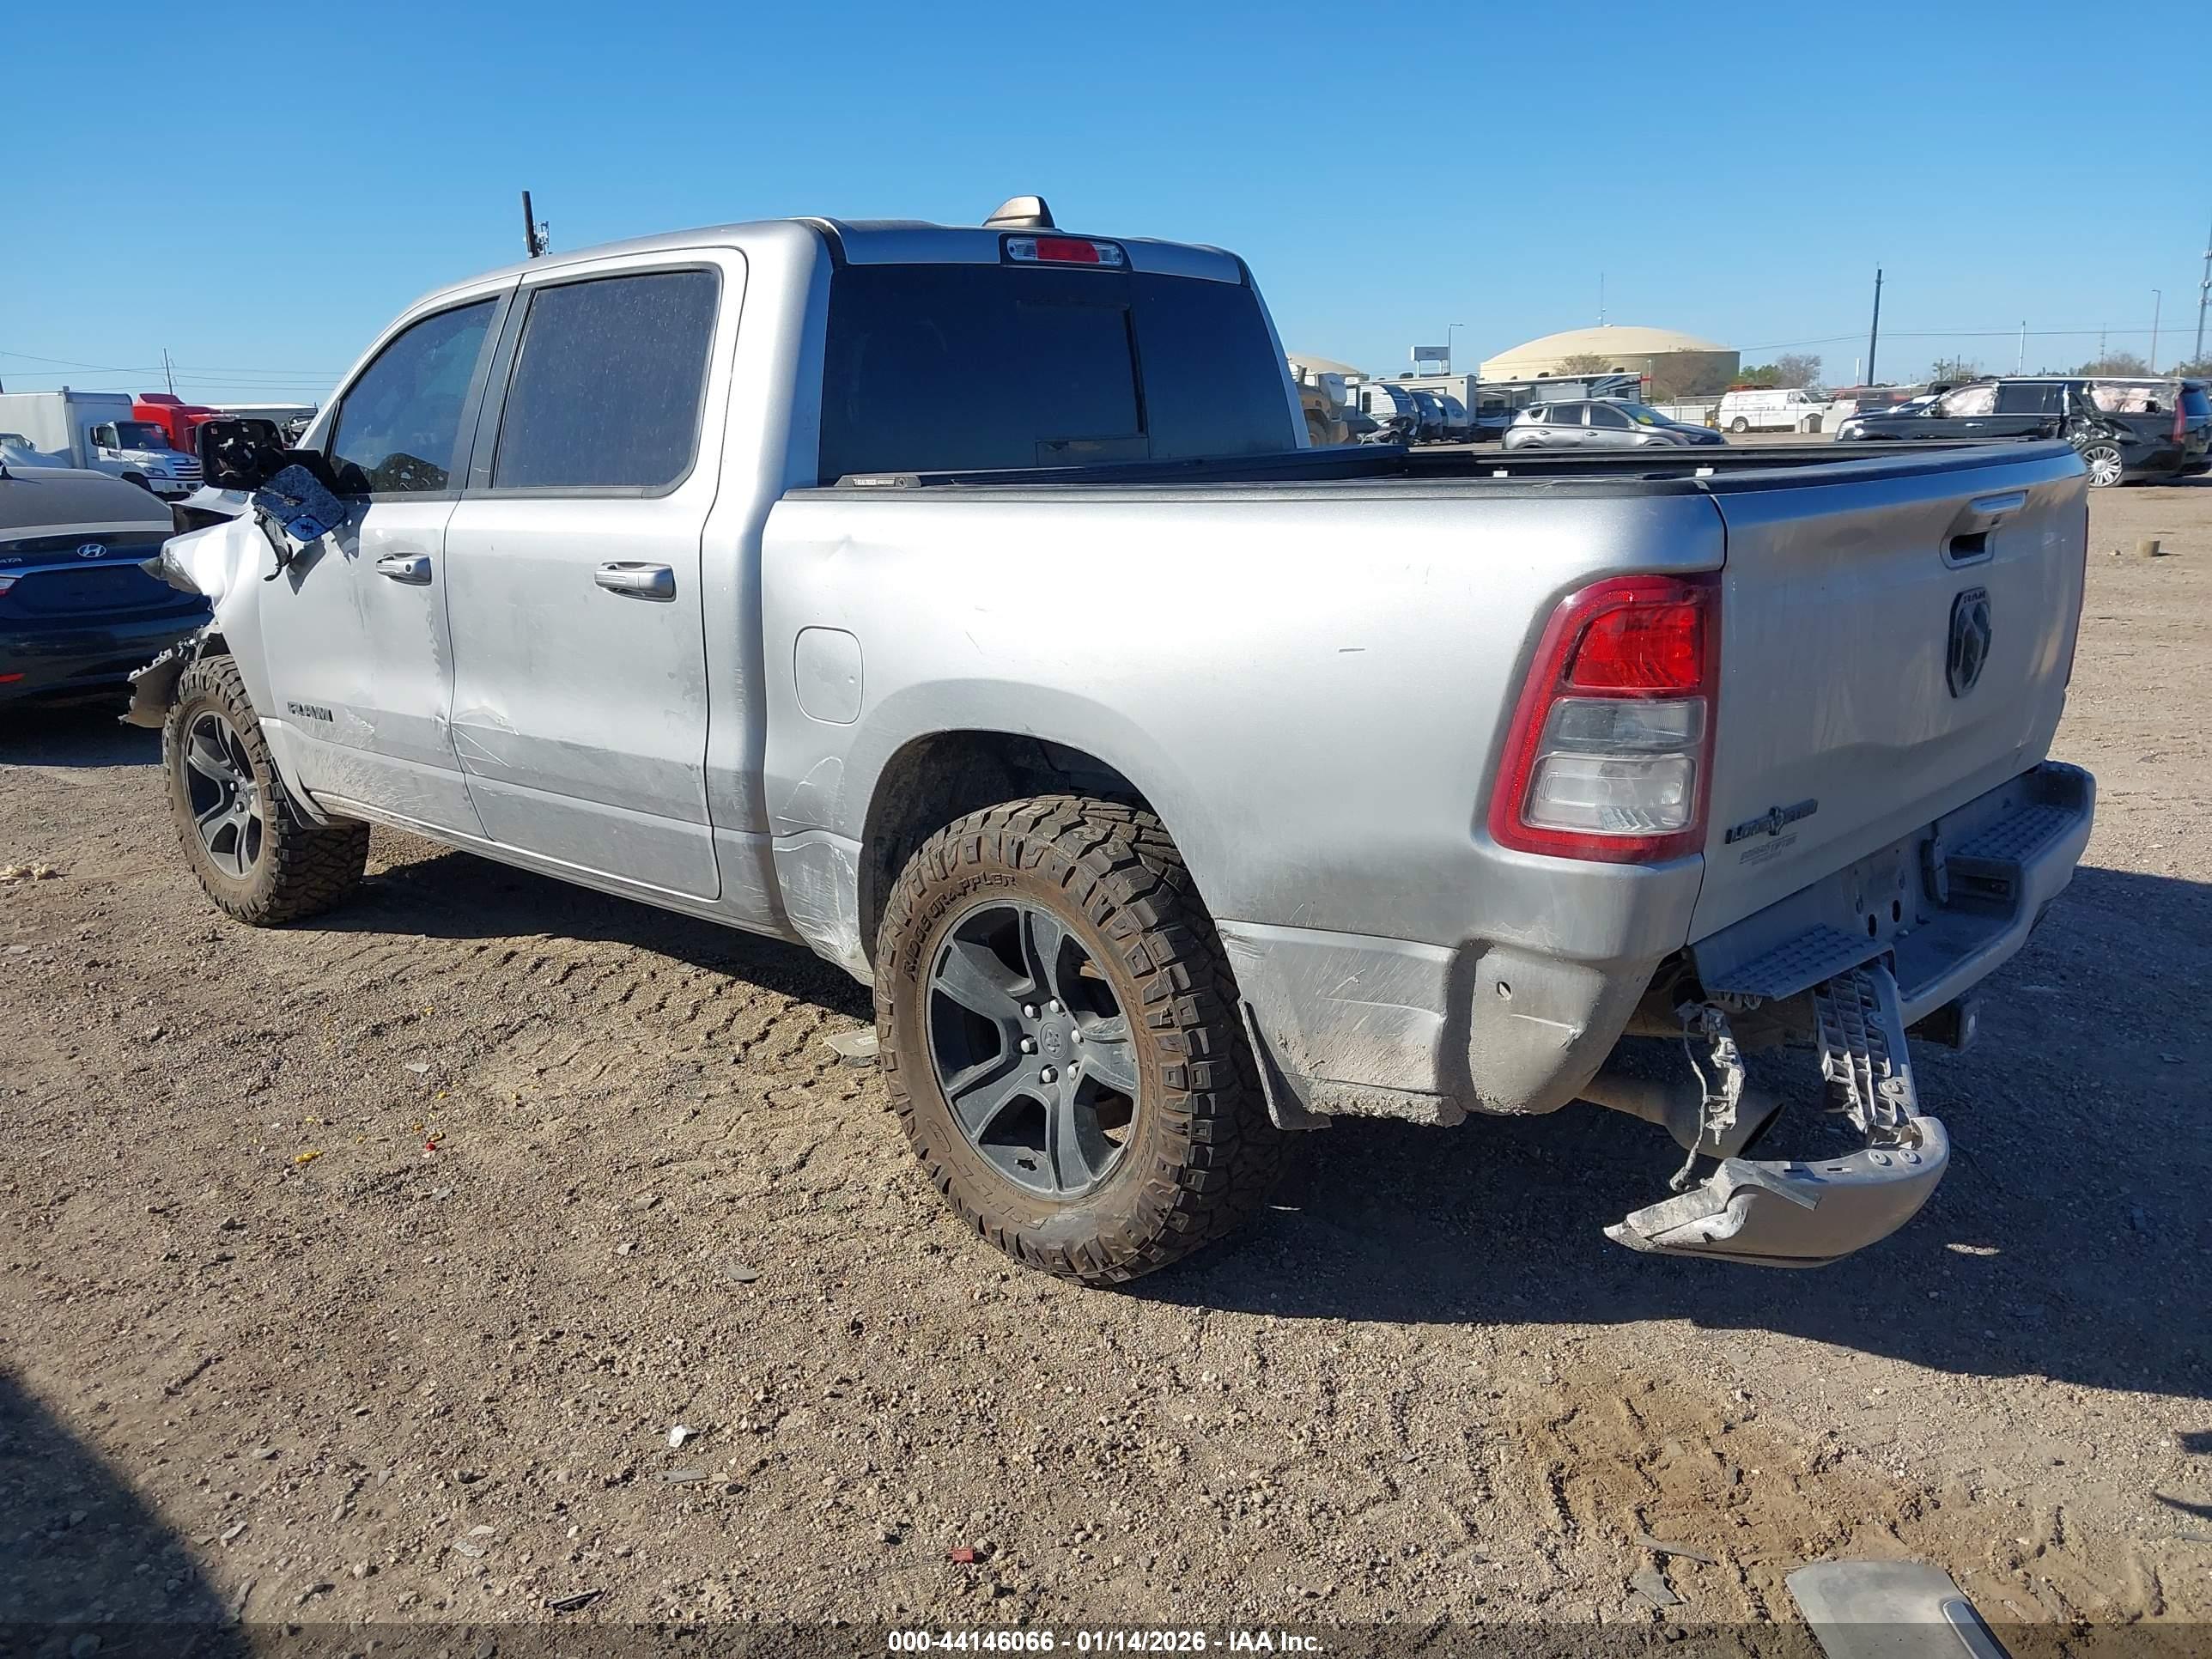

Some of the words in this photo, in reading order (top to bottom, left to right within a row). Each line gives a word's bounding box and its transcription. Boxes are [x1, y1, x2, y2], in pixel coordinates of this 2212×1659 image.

[1962, 589, 1986, 605] RAM
[287, 701, 334, 723] RAM
[902, 914, 933, 982] RIDGE
[928, 872, 1017, 919] GRAPPLER
